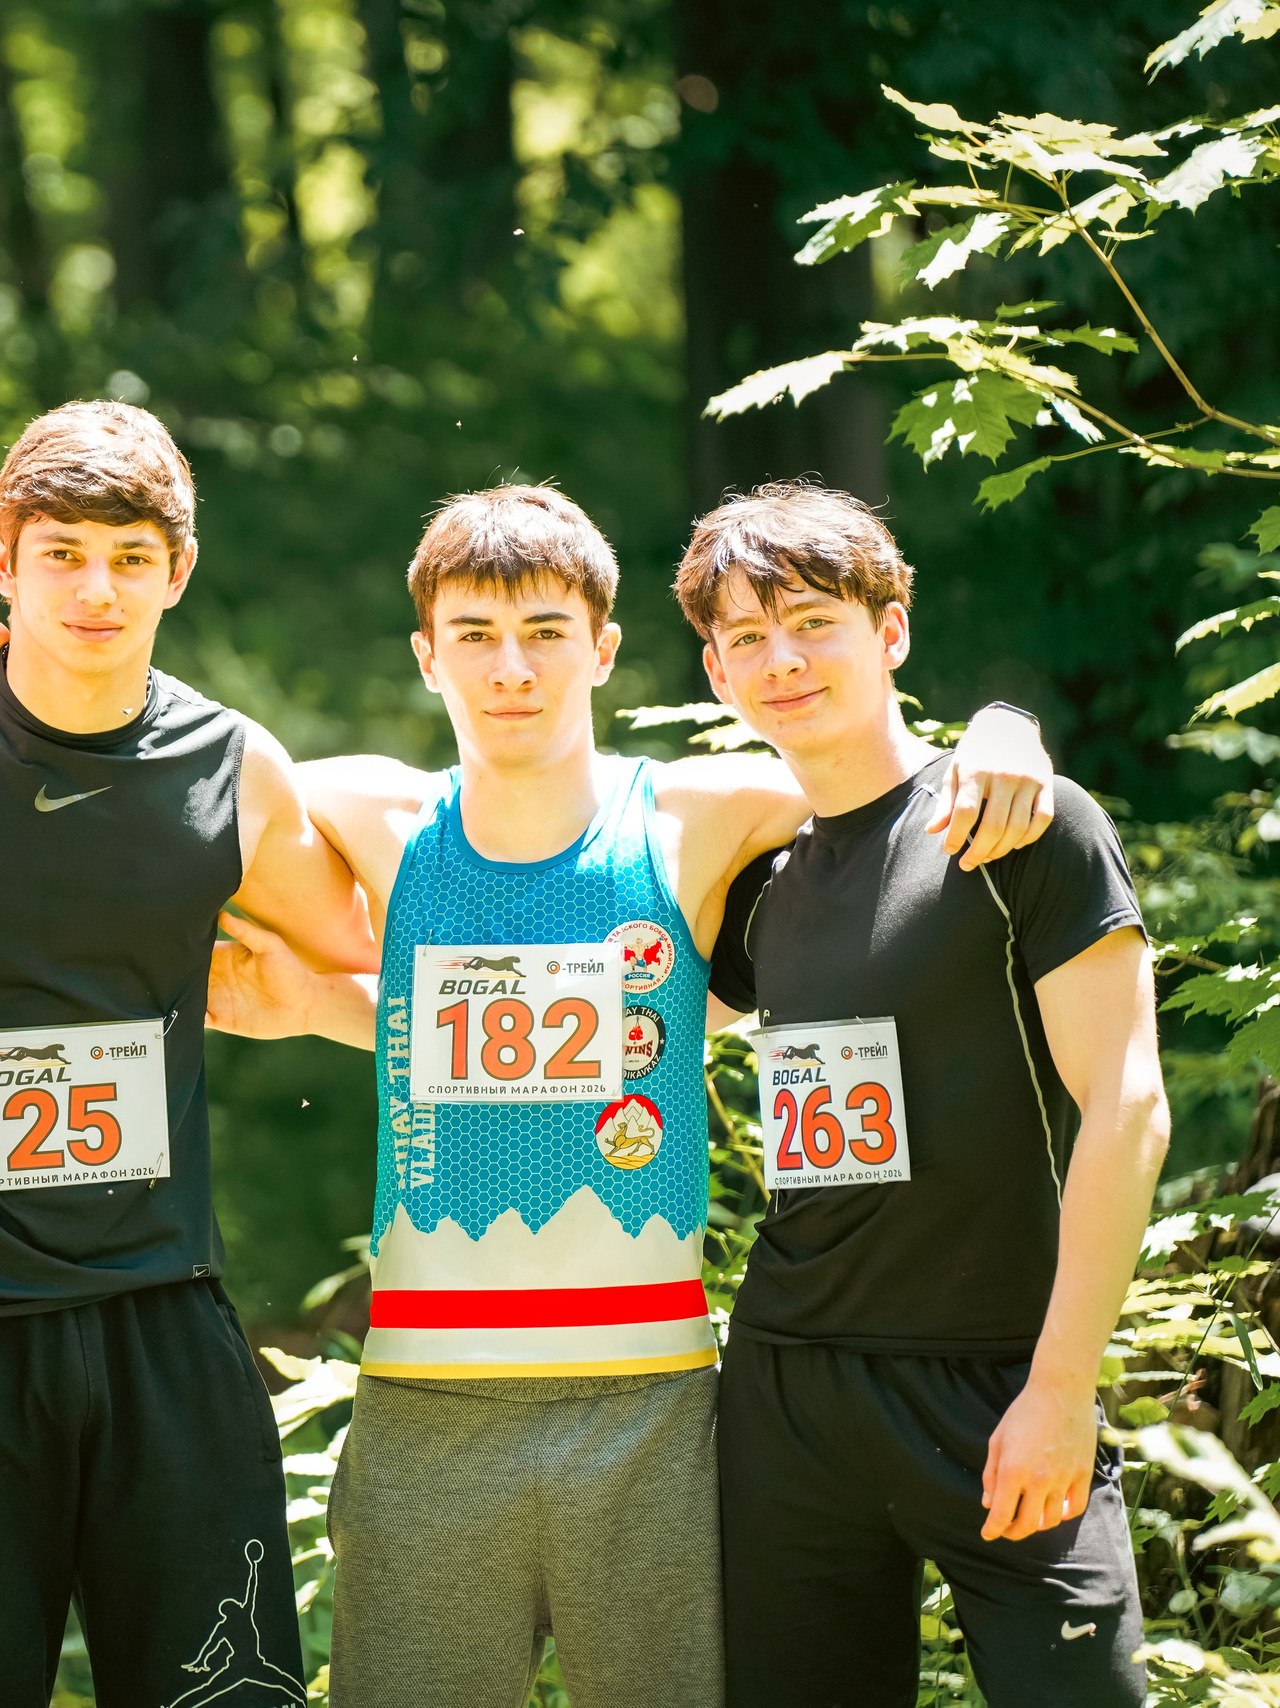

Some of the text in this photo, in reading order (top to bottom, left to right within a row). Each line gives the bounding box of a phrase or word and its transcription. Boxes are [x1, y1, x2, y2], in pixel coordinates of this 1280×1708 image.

[438, 979, 526, 995] BOGAL
[623, 977, 662, 991] ОРТИВНАЯ
[625, 1006, 660, 1023] AY THAI
[387, 996, 410, 1084] THAI
[436, 997, 602, 1081] 182
[624, 1039, 654, 1058] WINS
[623, 1054, 662, 1079] DIKAVKAZ
[772, 1067, 827, 1086] BOGAL
[428, 1084, 606, 1095] СПОРТИВНЫЙ МАРАФОН 2026
[2, 1082, 122, 1172] 25
[773, 1081, 897, 1171] 263
[410, 1103, 436, 1189] VLADI
[63, 1169, 127, 1182] МАРАФОН
[130, 1167, 155, 1177] 2026
[775, 1169, 902, 1186] СПОРТИВНЫЙ МАРАФОН 2026
